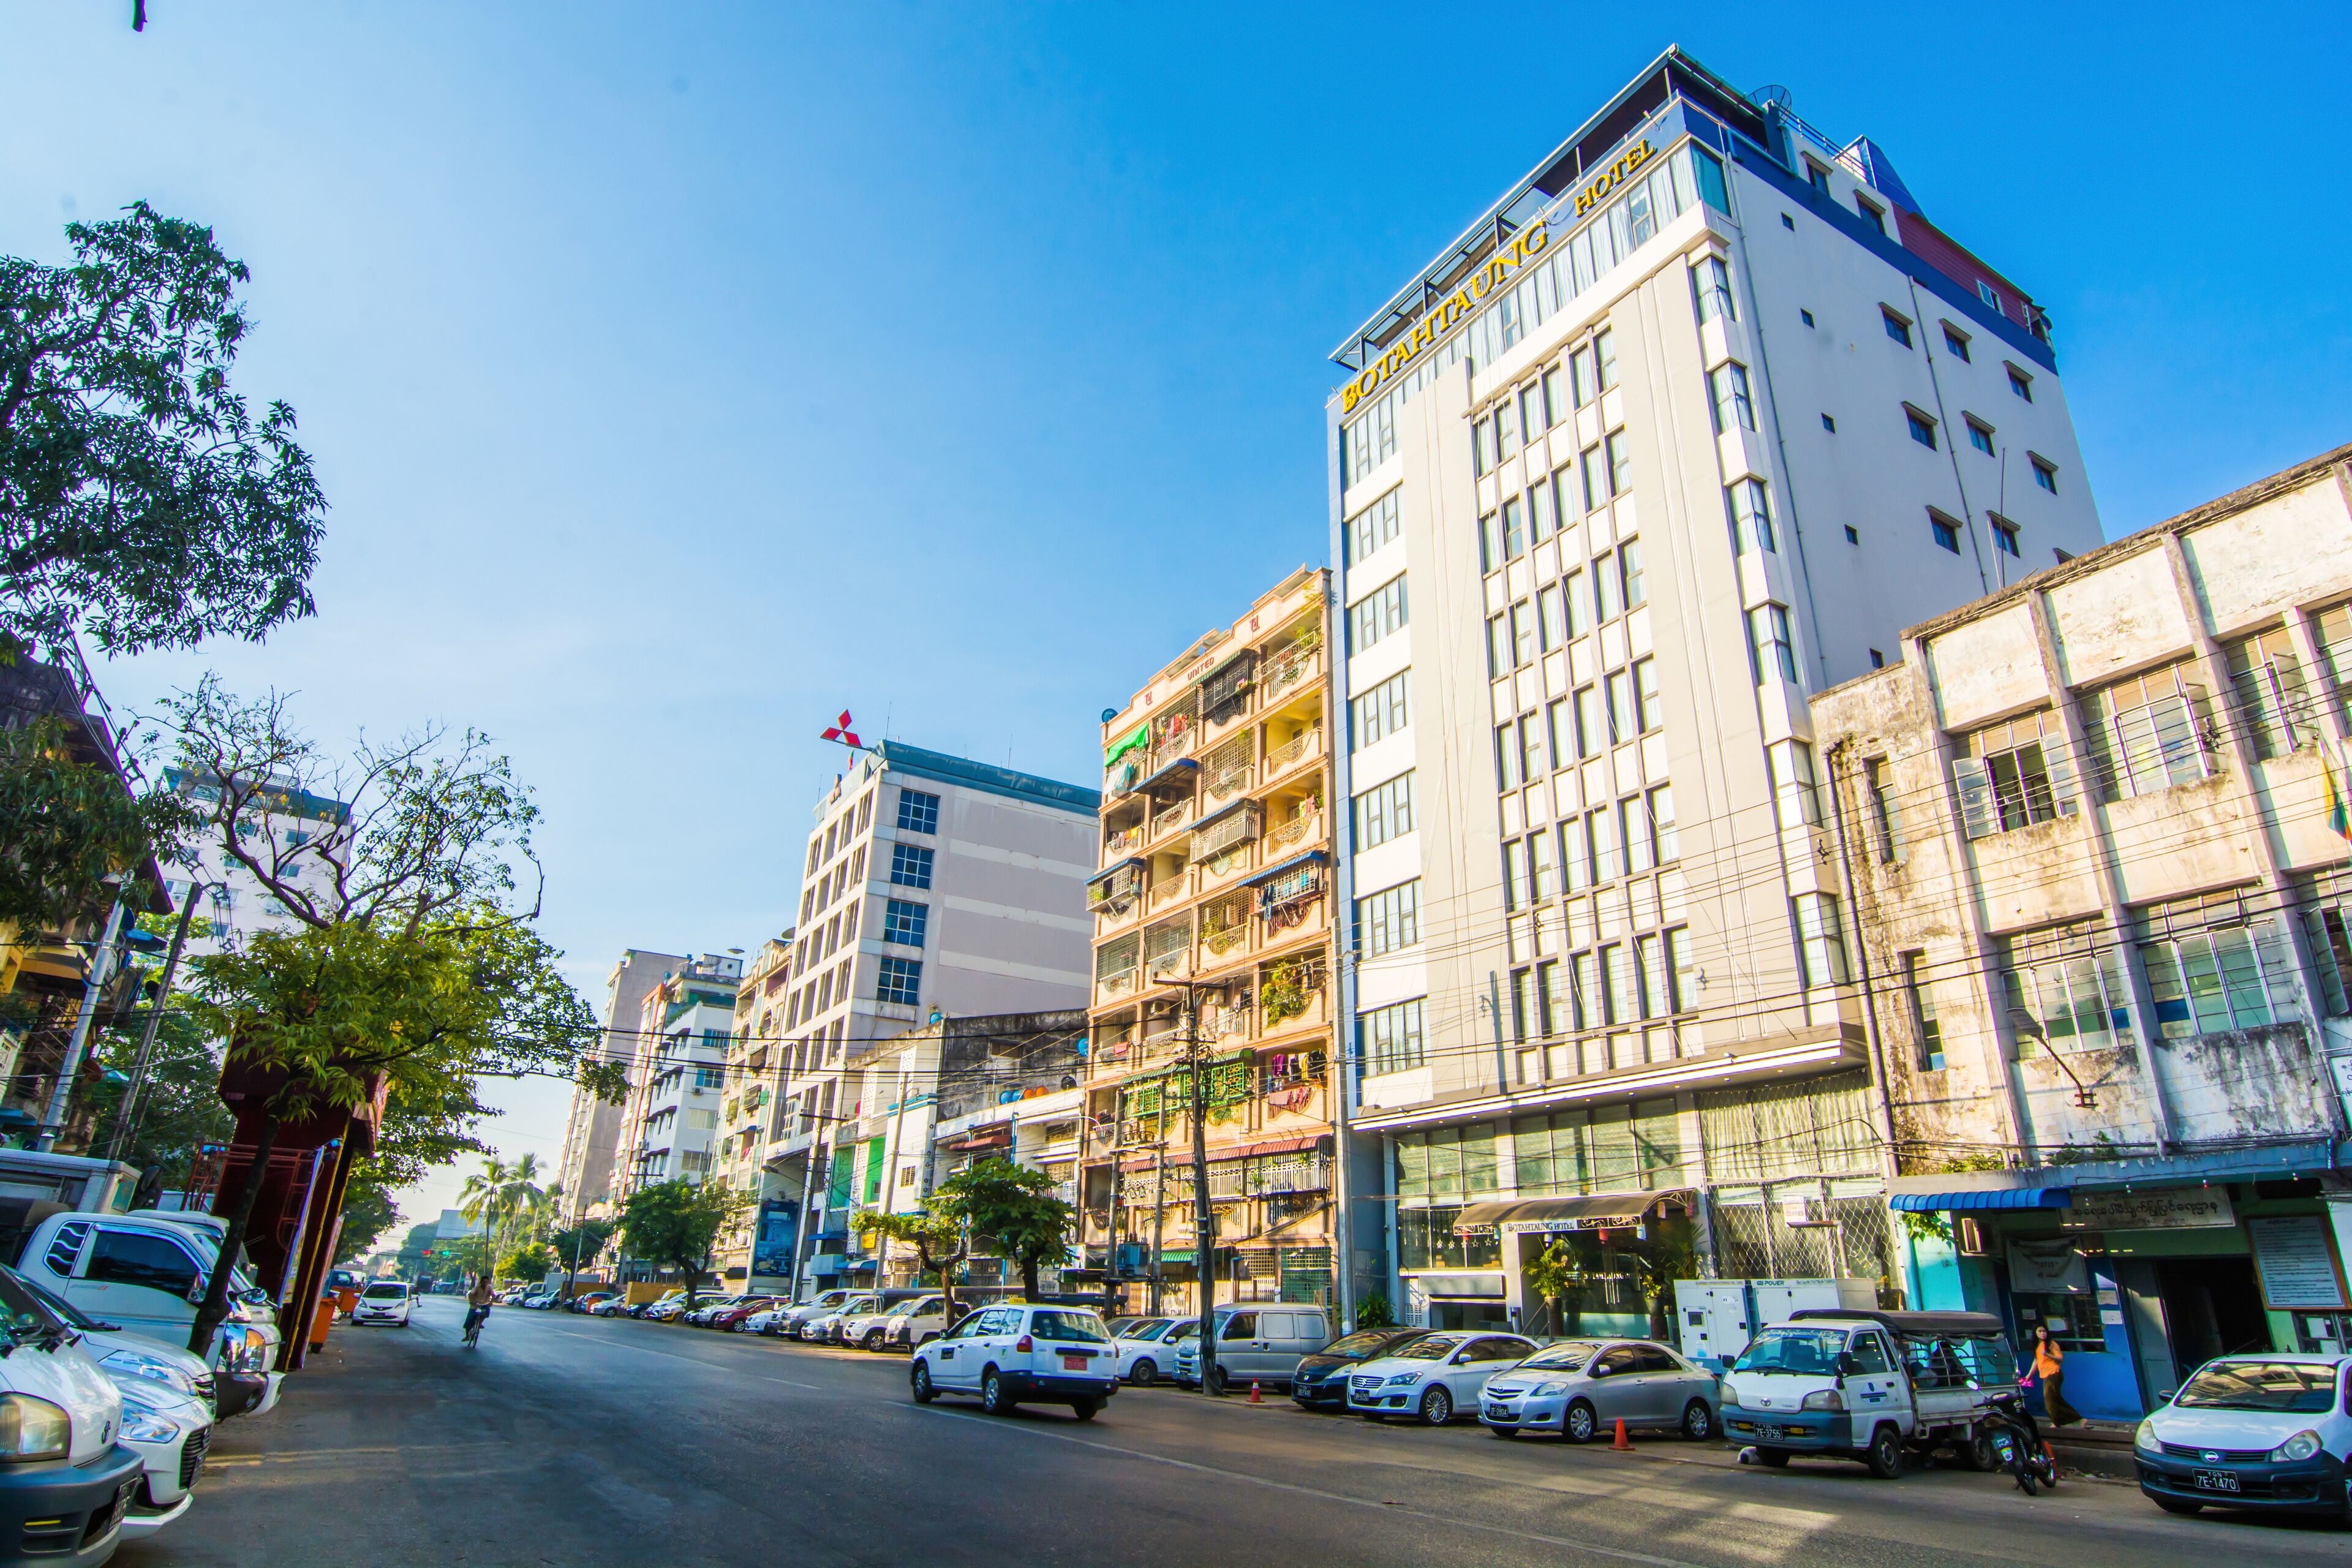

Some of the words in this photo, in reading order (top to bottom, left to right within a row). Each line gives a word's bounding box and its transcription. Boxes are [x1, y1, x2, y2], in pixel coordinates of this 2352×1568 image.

[1342, 220, 1548, 414] BOTAHTAUNG
[1574, 138, 1657, 217] HOTEL
[1188, 657, 1214, 680] UNITED
[1507, 1222, 1553, 1232] BOTAHTAUNG
[1555, 1221, 1574, 1230] HOTEL
[1756, 1428, 1781, 1438] 7E-3755
[2196, 1476, 2236, 1490] 7E-1470
